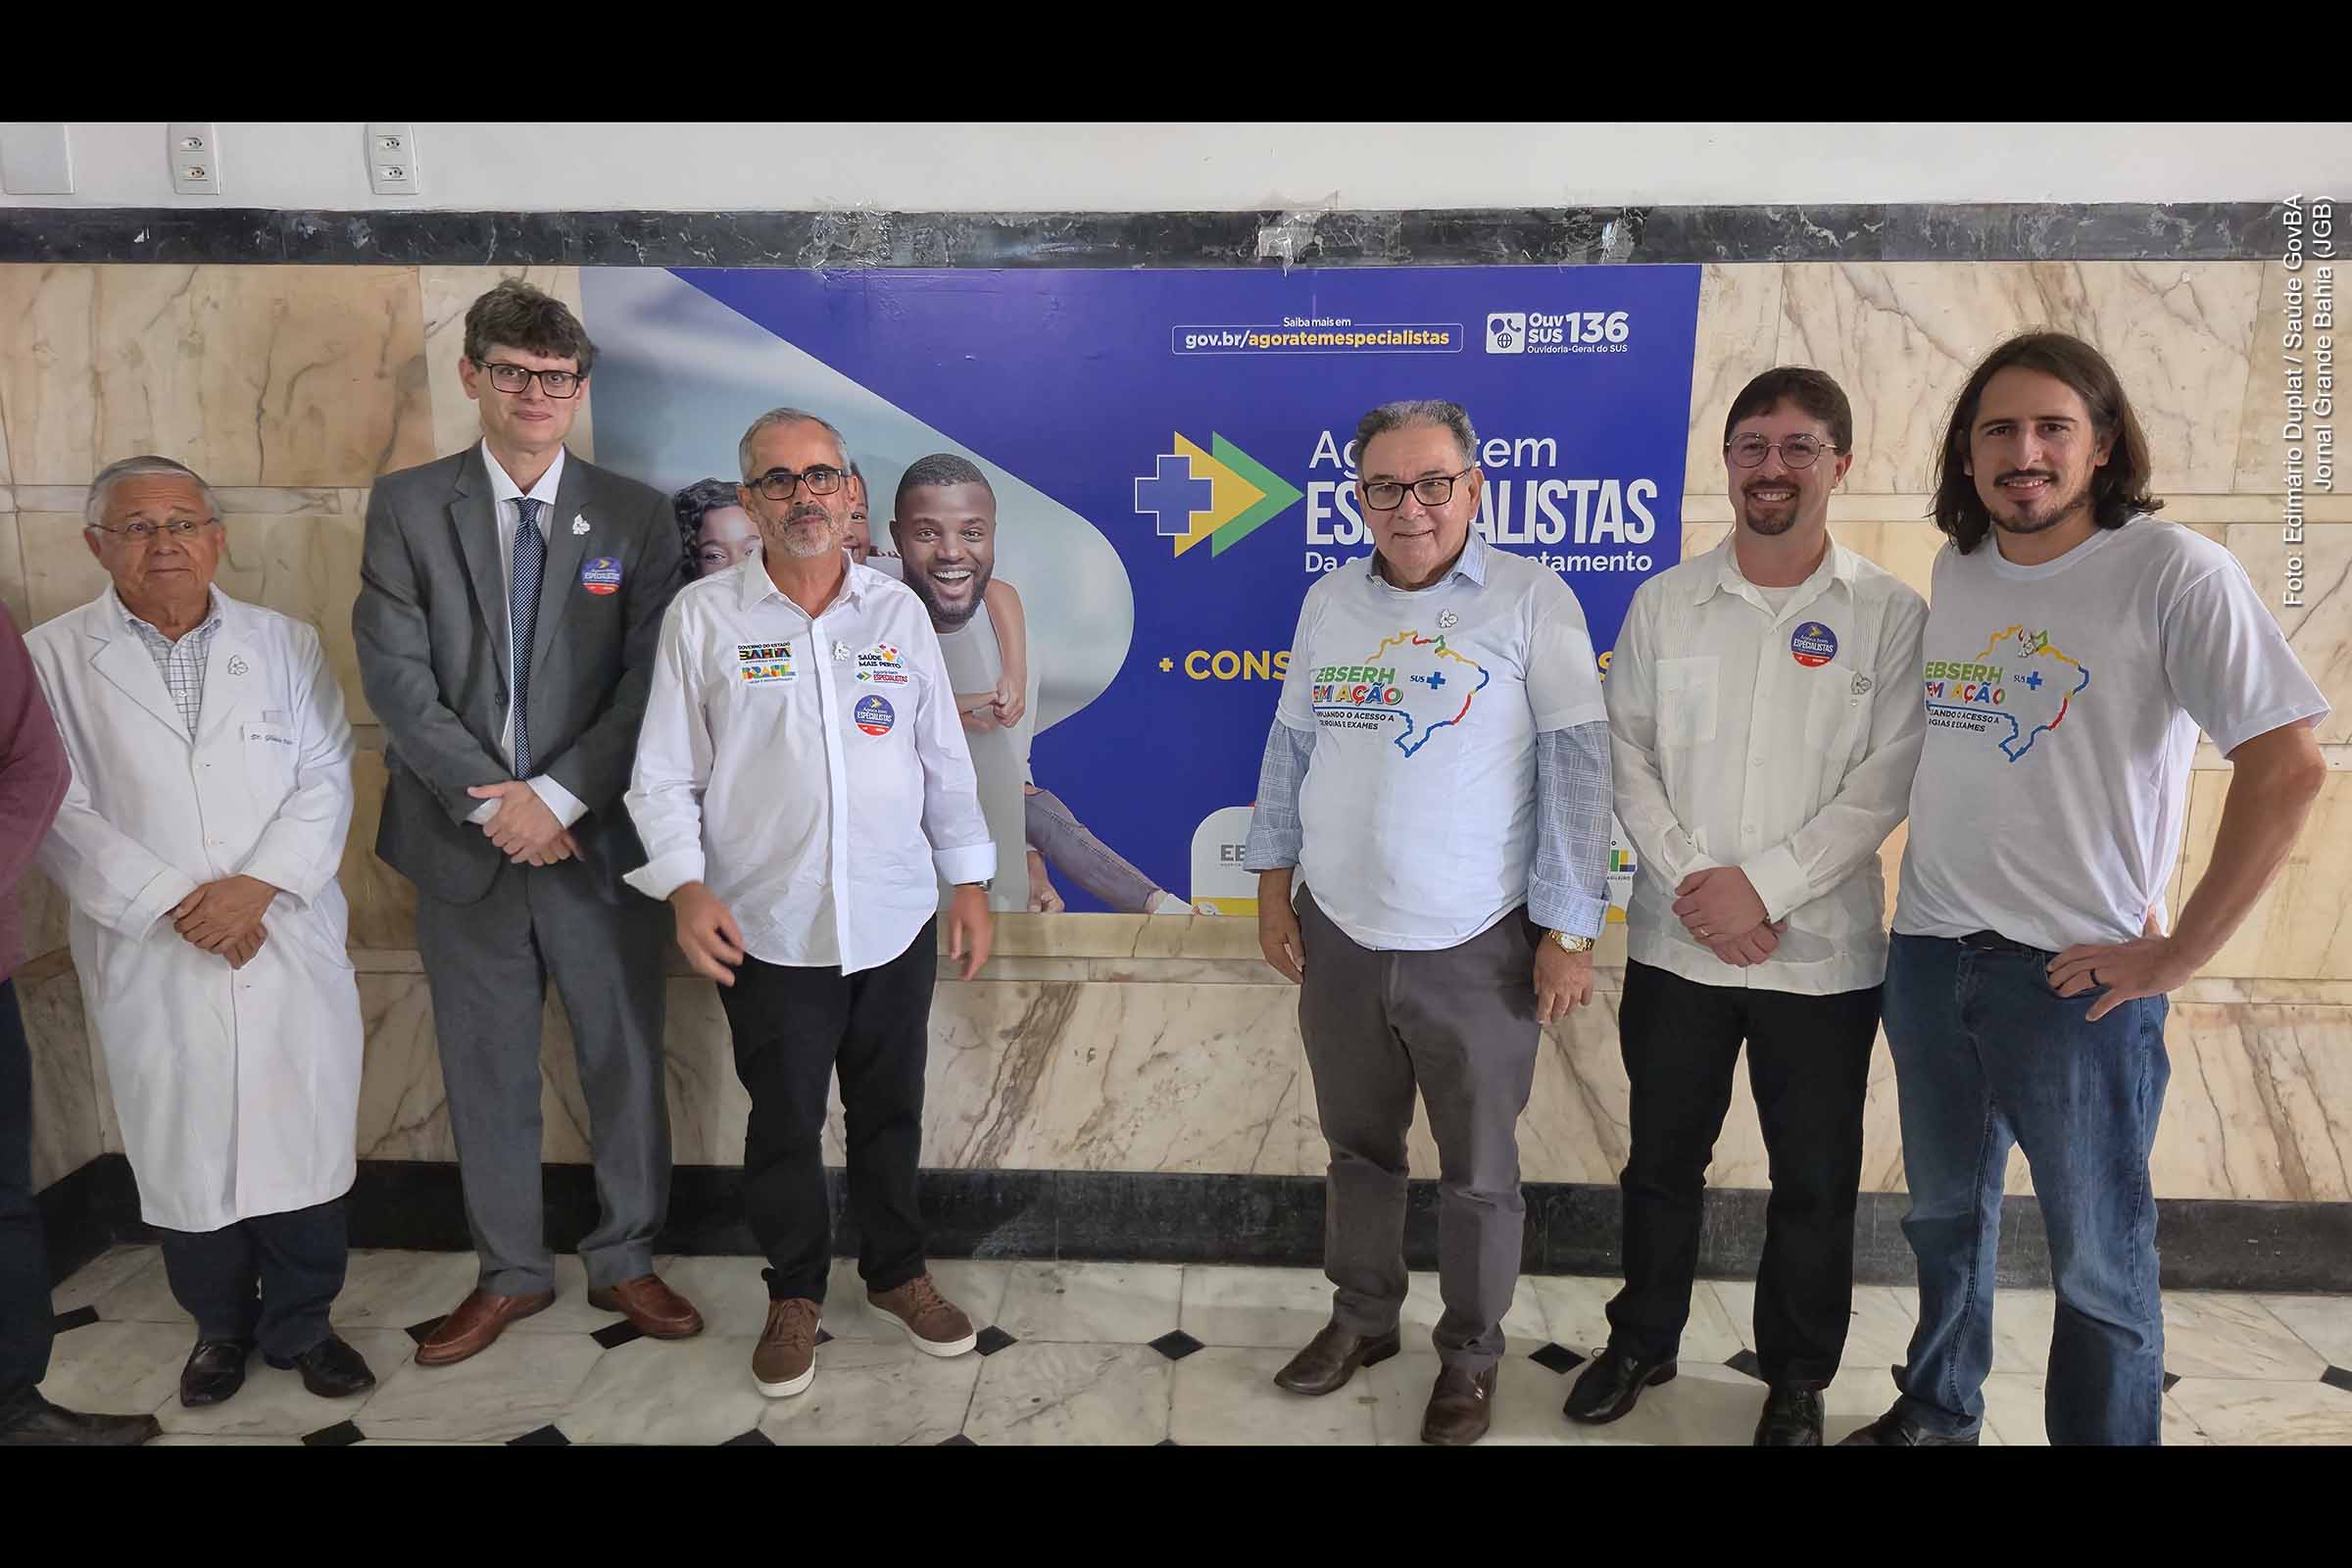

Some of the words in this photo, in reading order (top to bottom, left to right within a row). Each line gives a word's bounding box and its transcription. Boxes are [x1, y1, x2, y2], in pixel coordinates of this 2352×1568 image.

[1283, 317, 1312, 327] Saiba
[1312, 318, 1335, 327] mais
[1528, 313, 1564, 327] Ouv
[1565, 311, 1630, 343] 136
[1185, 330, 1449, 350] gov.br/agoratemespecialistas
[1528, 328, 1563, 343] SUS
[1527, 344, 1595, 354] Ouvidoria-Geral
[1609, 344, 1628, 353] SUS
[1304, 551, 1339, 573] Da
[1410, 674, 1425, 683] SUS
[1926, 662, 2004, 685] EBSERH
[1335, 681, 1404, 707] AÇÃO
[1951, 681, 2006, 707] AÇÃO
[1353, 712, 1387, 721] ACESSO
[1347, 721, 1379, 730] EXAMES
